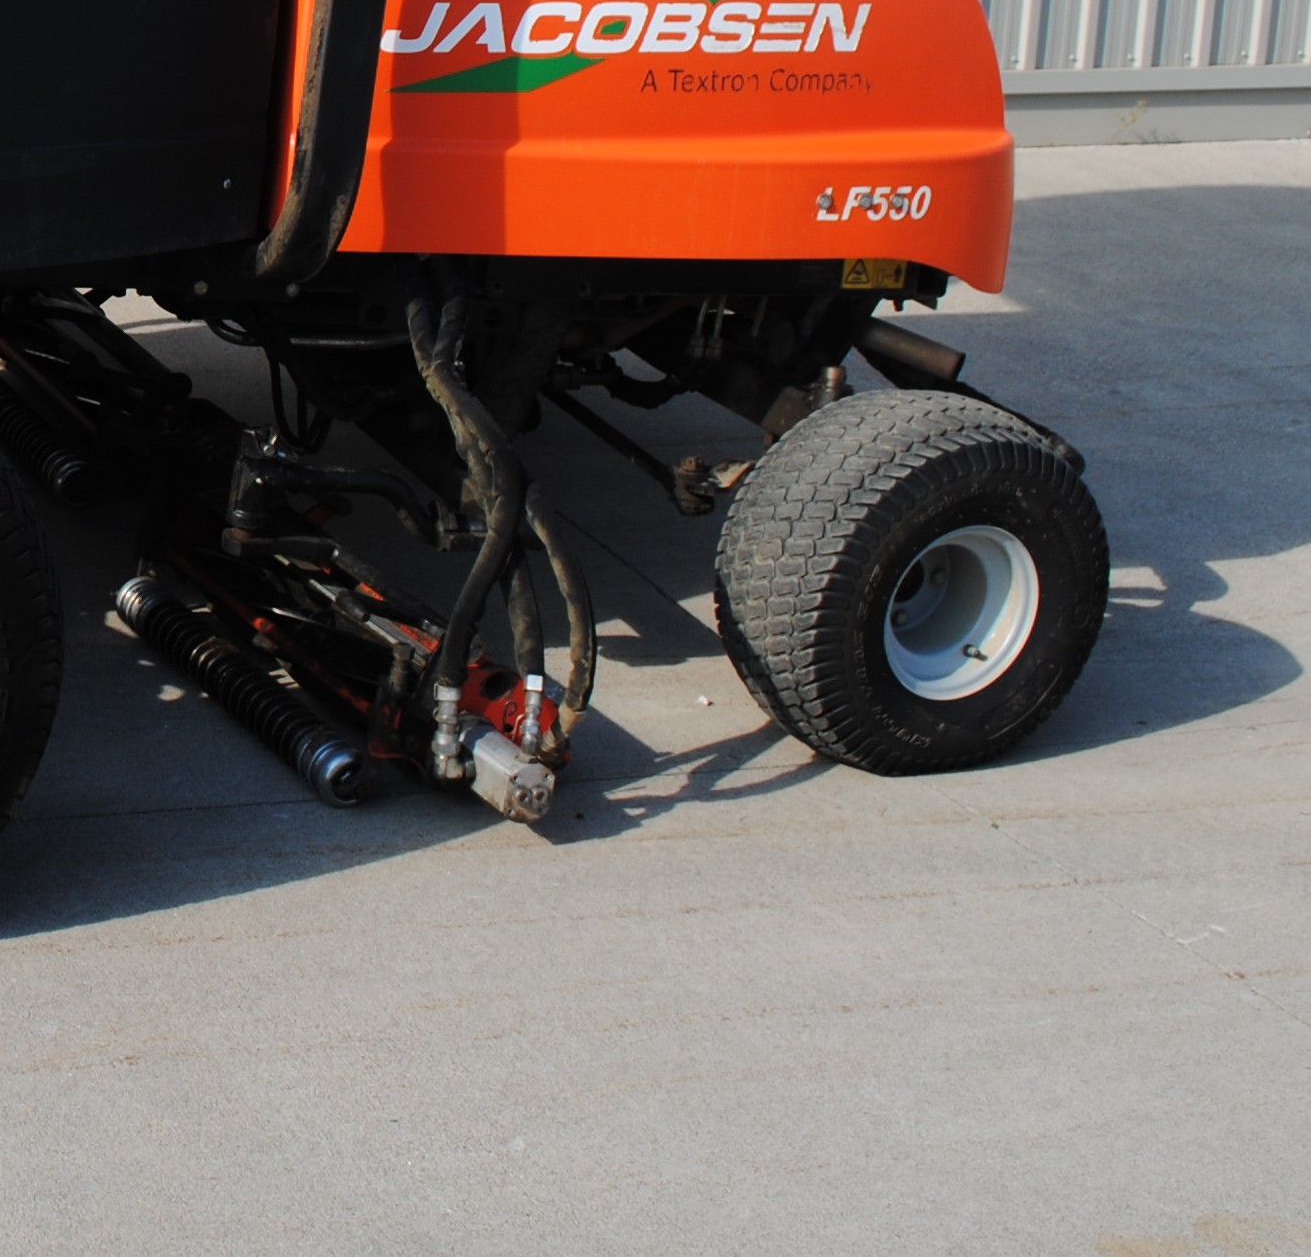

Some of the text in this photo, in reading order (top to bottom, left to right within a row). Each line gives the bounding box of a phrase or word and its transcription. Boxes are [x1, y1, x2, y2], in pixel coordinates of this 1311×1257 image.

[380, 1, 872, 55] JACOBSEN
[640, 69, 658, 93] A
[668, 68, 760, 93] Textron
[815, 184, 933, 222] LF550
